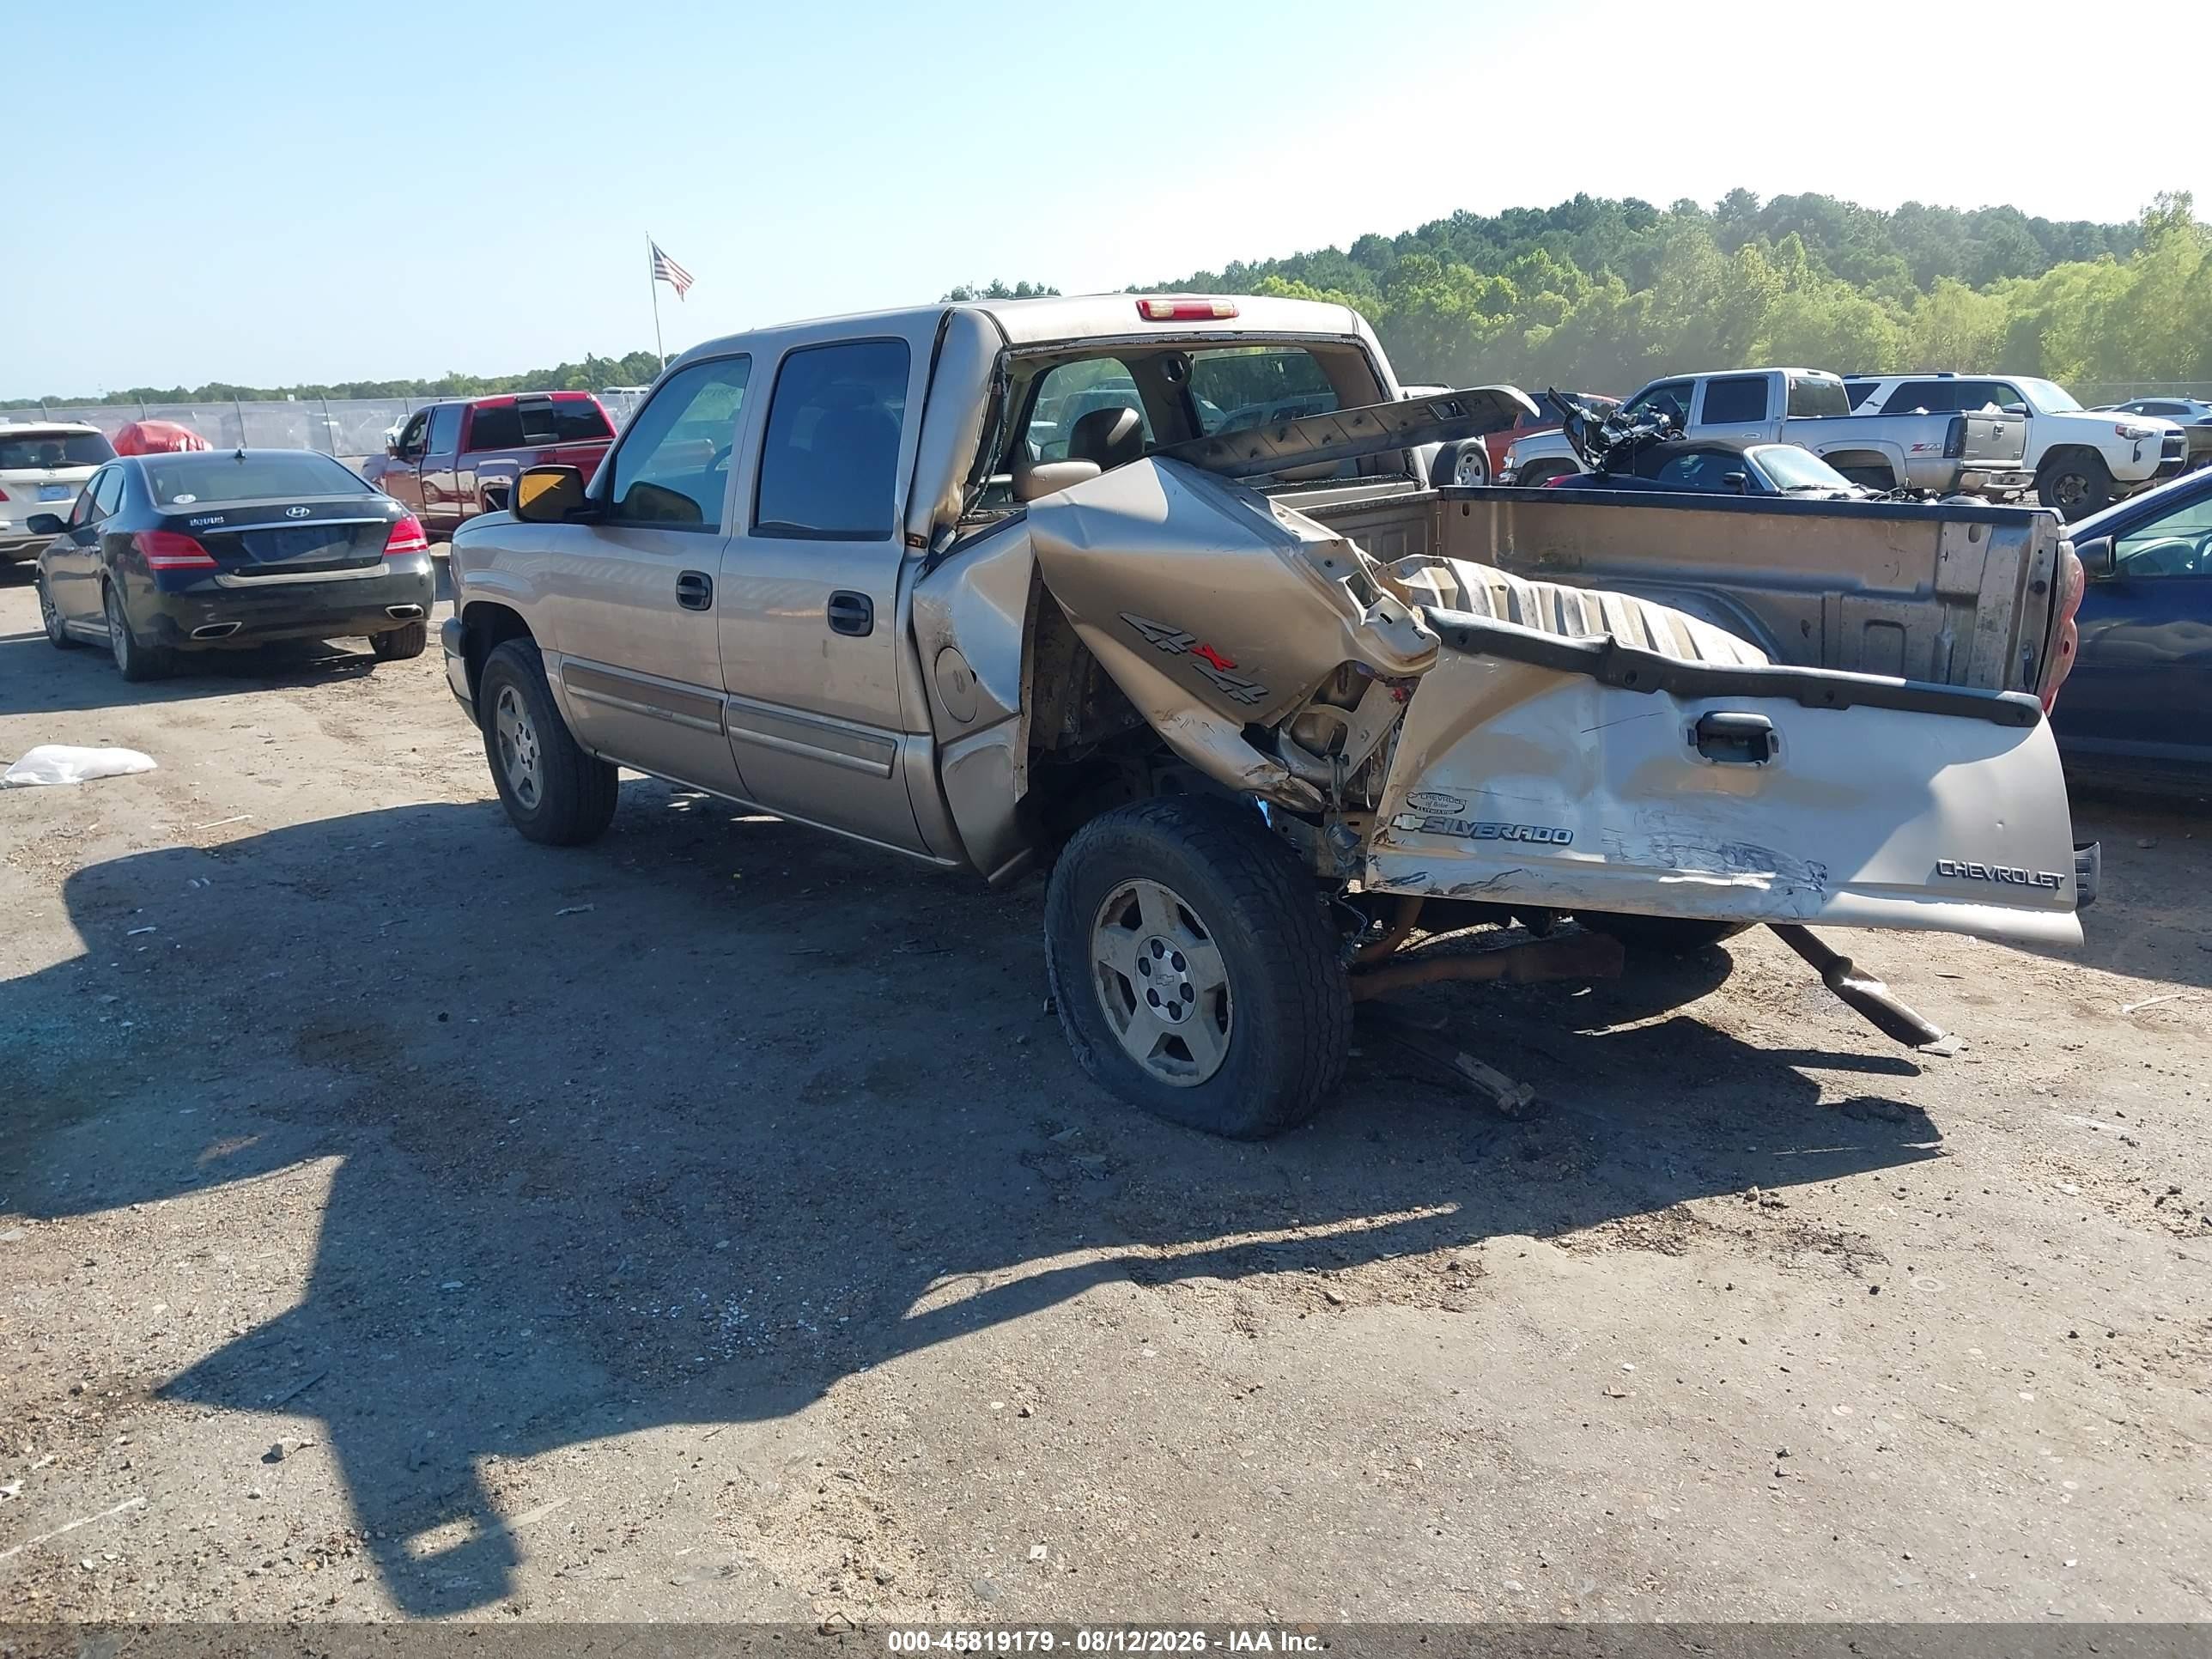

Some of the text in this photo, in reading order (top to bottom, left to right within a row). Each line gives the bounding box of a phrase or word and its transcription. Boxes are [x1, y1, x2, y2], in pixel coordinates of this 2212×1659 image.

[1420, 793, 1467, 805] CHEVROLET
[1420, 816, 1573, 845] SILVERADO
[1936, 859, 2065, 890] CHEVROLET
